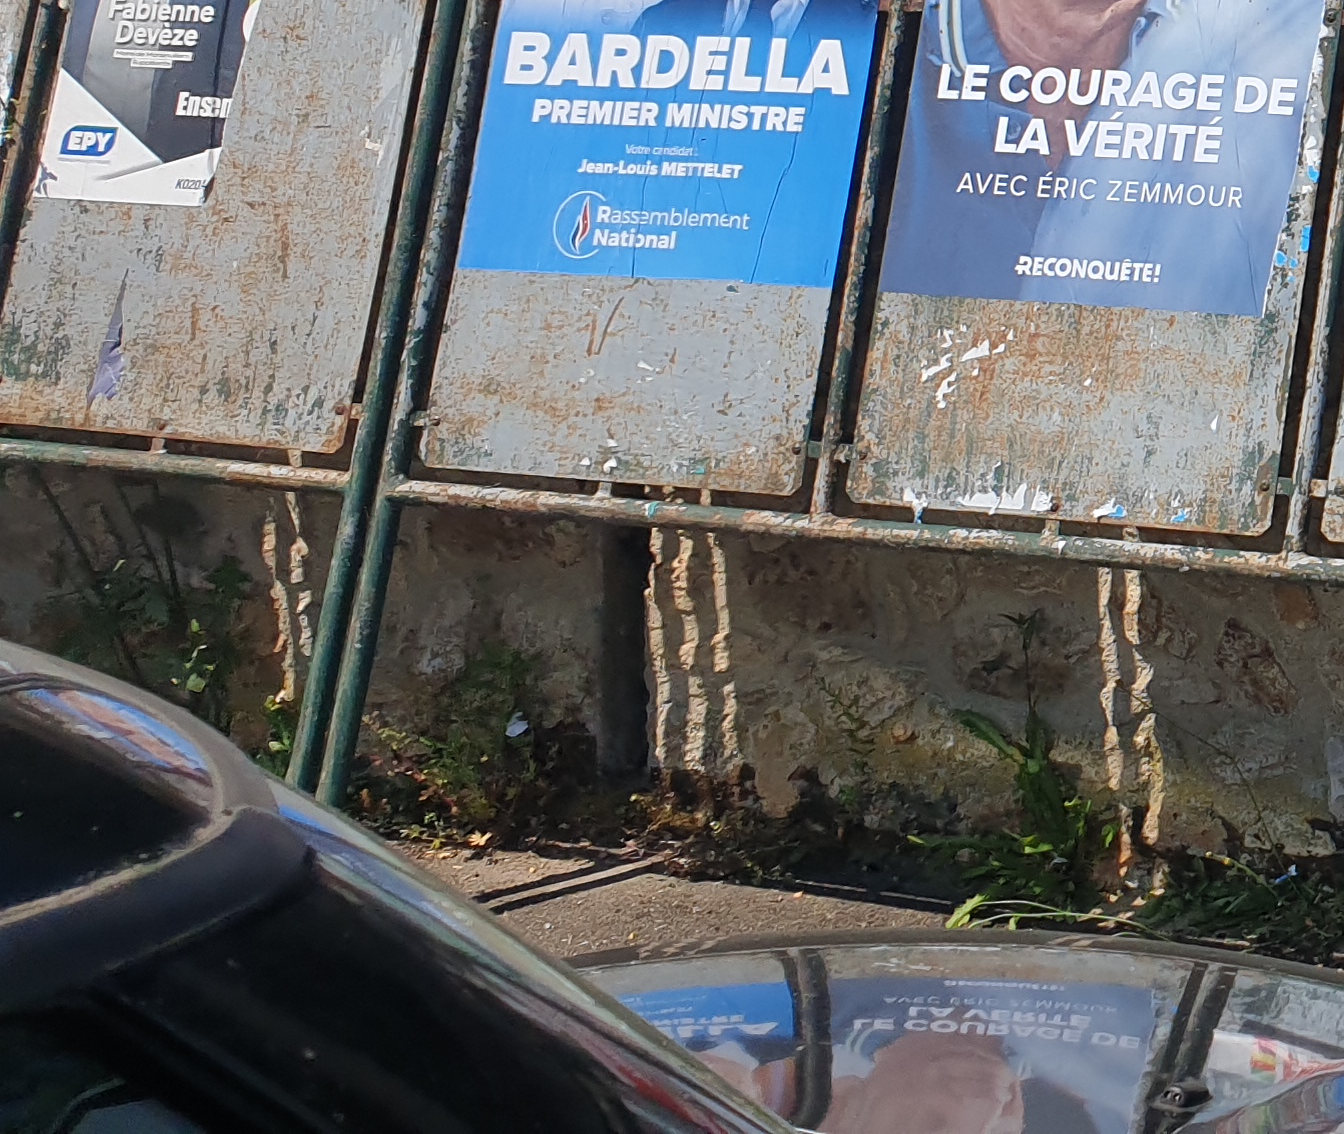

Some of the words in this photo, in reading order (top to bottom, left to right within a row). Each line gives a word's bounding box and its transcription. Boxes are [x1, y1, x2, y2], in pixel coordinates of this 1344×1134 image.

[115, 21, 198, 46] Devèze
[503, 31, 850, 95] BARDELLA
[937, 64, 990, 101] LE
[1000, 65, 1225, 111] COURAGE
[1234, 76, 1298, 116] DE
[532, 99, 659, 126] PREMIER
[665, 103, 805, 132] MINISTRE
[67, 131, 114, 151] EPY
[626, 144, 650, 155] Votre
[994, 116, 1050, 155] LA
[1064, 112, 1224, 164] VÉRITÉ
[578, 159, 658, 176] Jean-Louis
[662, 161, 743, 179] METTELET
[956, 172, 1028, 195] AVEC
[1036, 172, 1098, 200] ÉRIC
[1107, 180, 1242, 208] ZEMMOUR
[596, 206, 750, 230] Rassemblement
[592, 230, 677, 249] National
